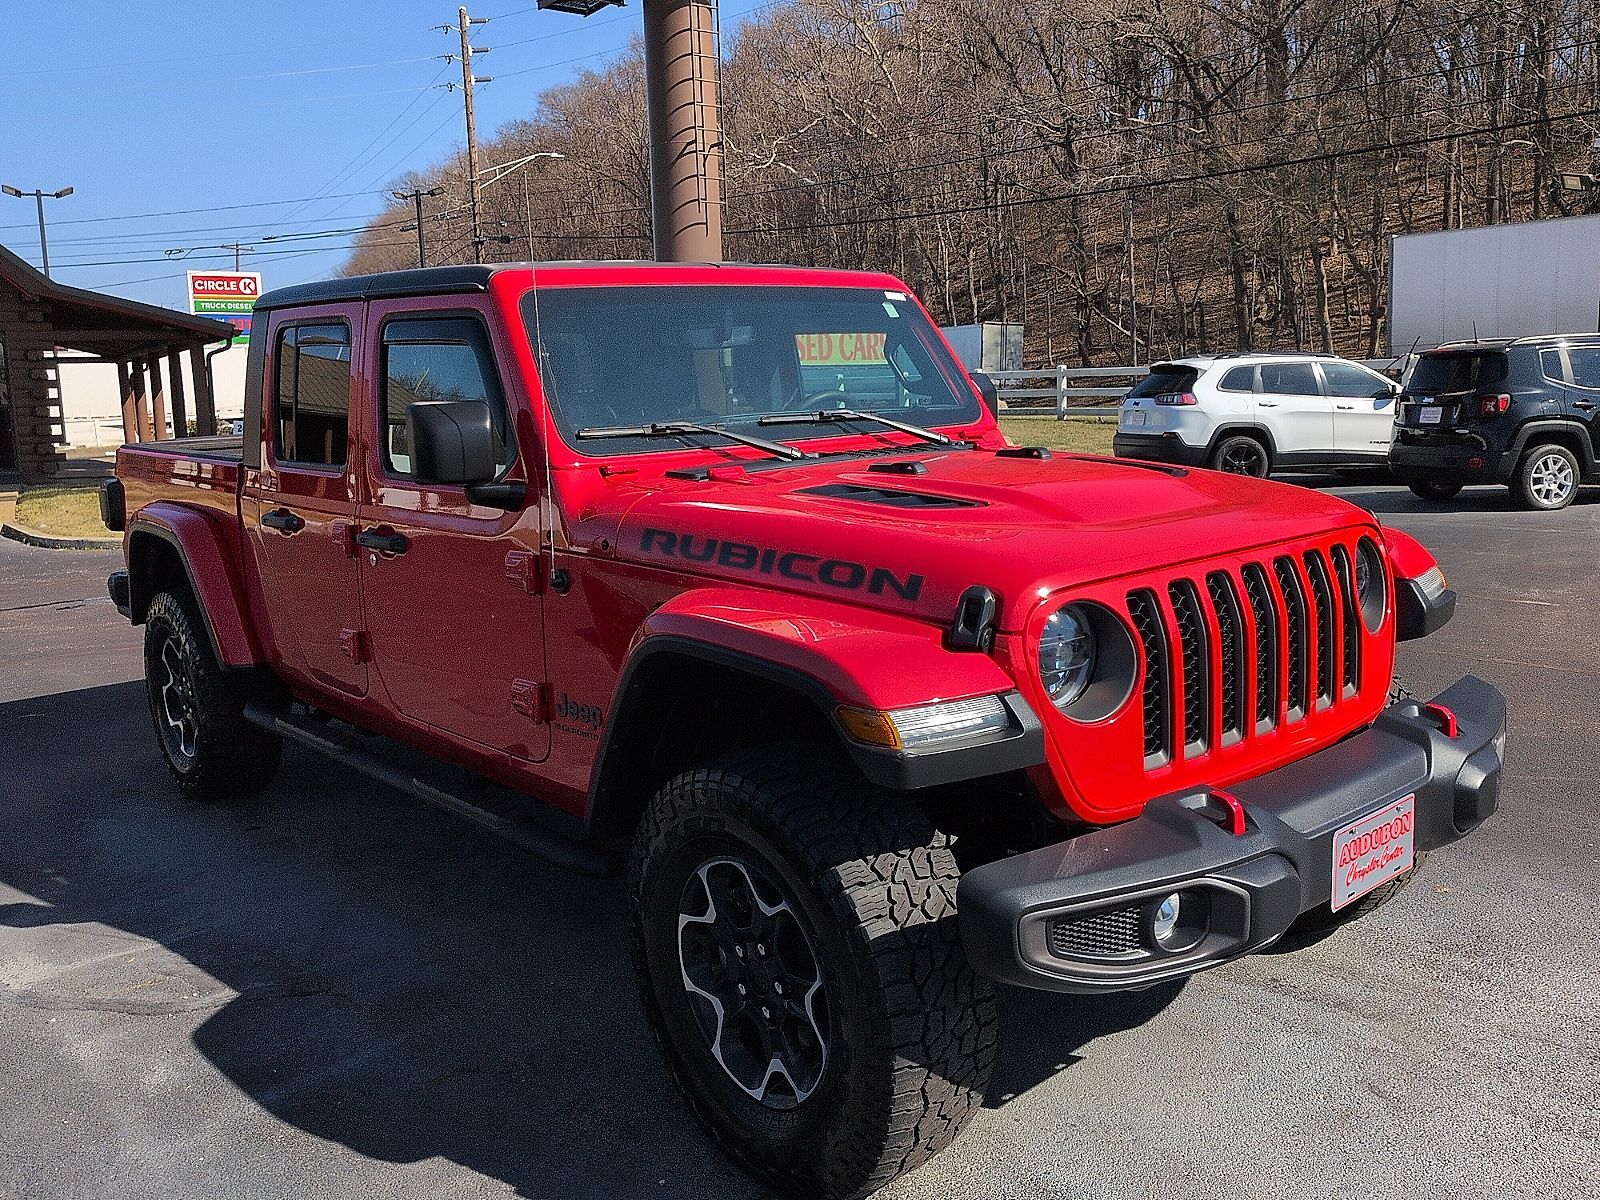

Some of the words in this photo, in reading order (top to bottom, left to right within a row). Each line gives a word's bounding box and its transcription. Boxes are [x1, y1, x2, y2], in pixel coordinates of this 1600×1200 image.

[194, 280, 238, 291] CIRCLE
[796, 334, 832, 361] SED
[639, 527, 926, 603] RUBICON
[555, 692, 602, 729] Jeep
[1339, 811, 1412, 868] AUDUBON
[1345, 855, 1381, 887] Chrysler
[1379, 844, 1404, 869] Center
